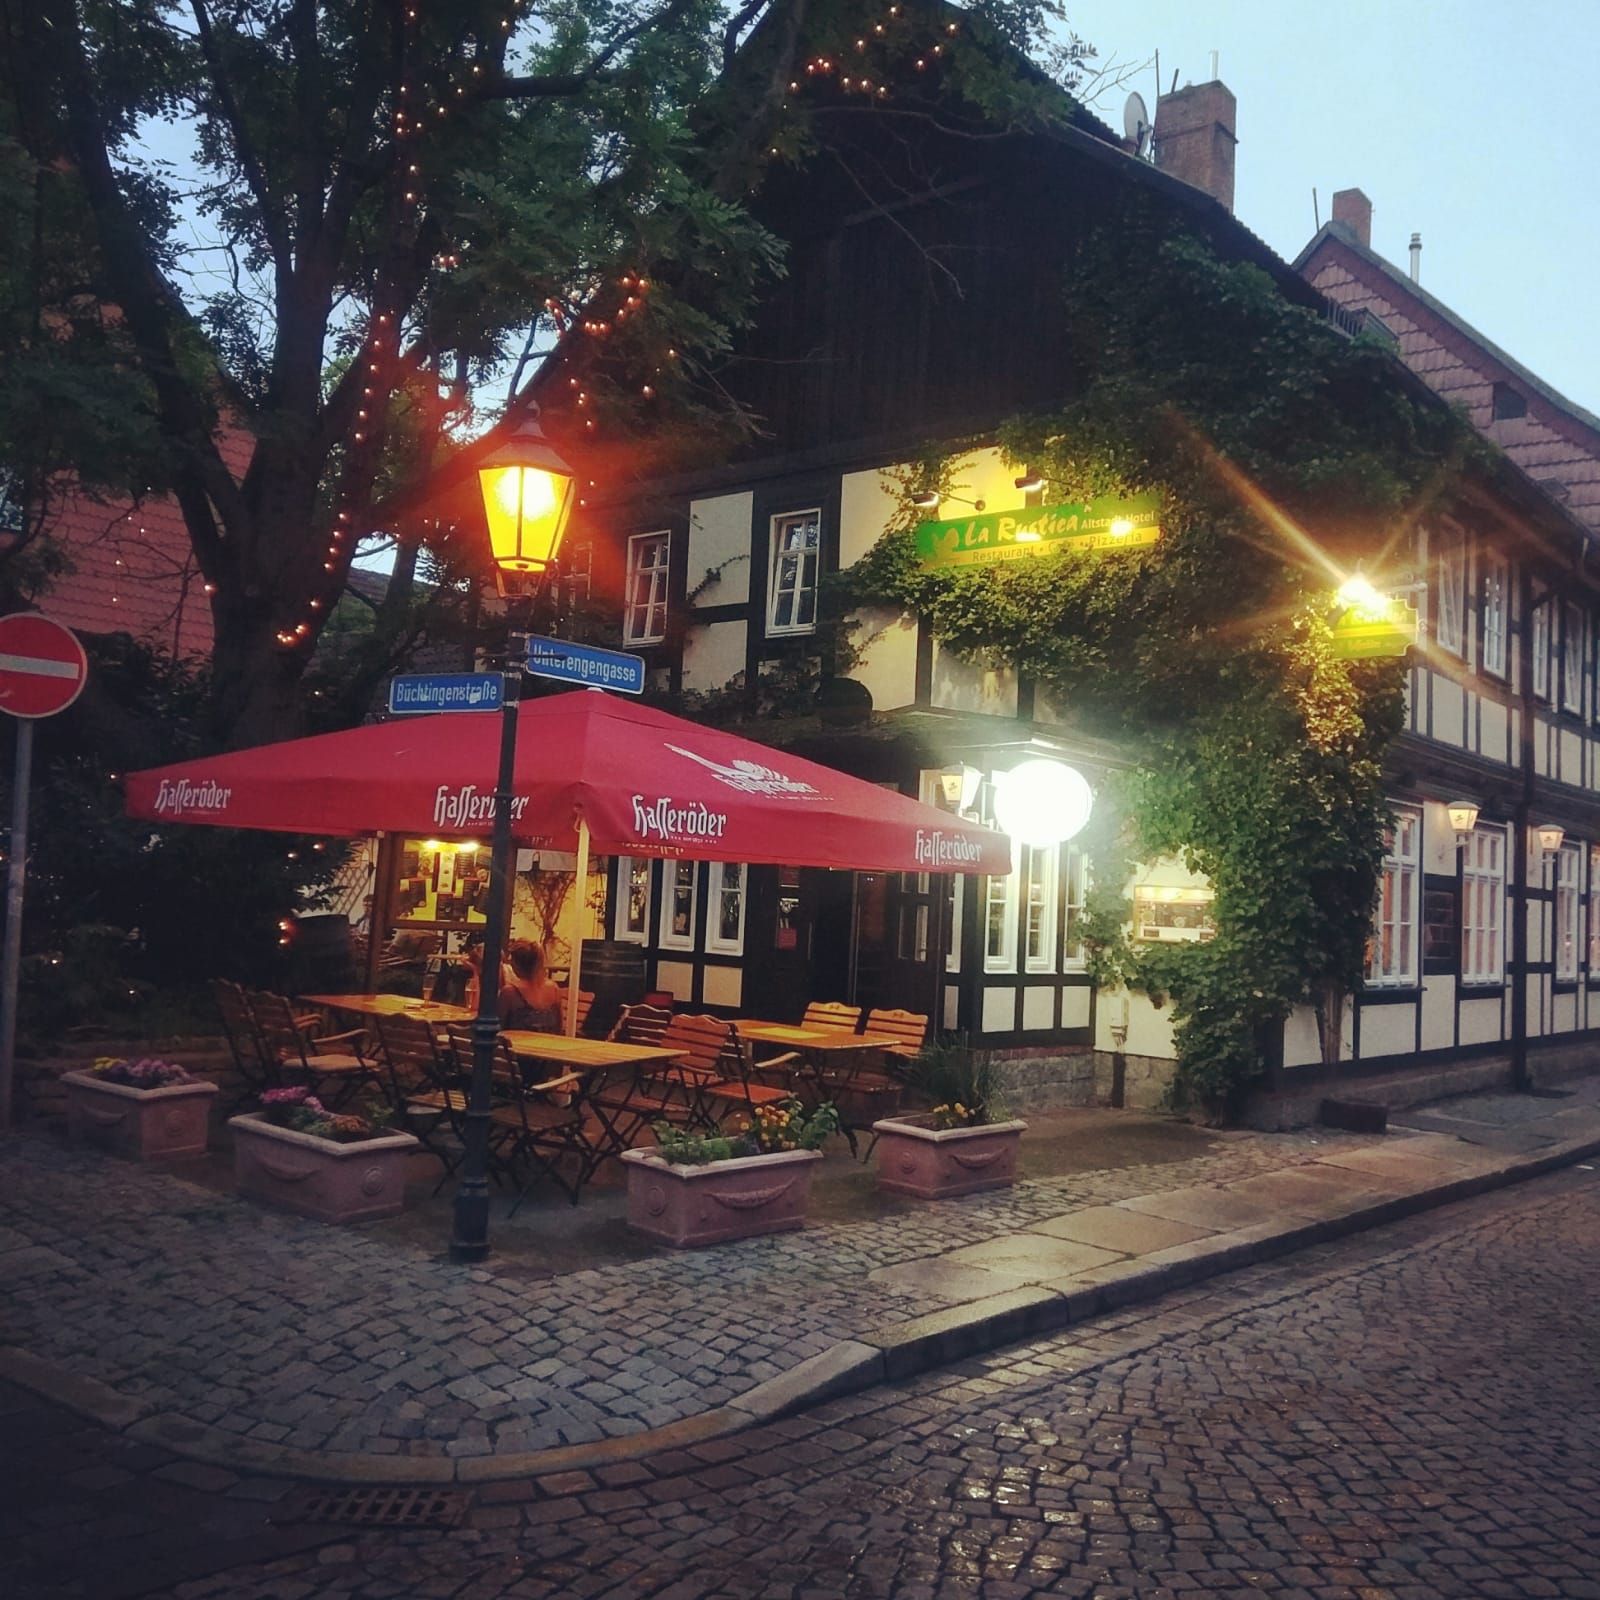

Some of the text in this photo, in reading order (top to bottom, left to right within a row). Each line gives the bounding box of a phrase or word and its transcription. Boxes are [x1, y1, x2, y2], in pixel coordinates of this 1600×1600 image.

[965, 513, 1078, 546] La Rustica
[972, 546, 1034, 561] Restaurant
[433, 785, 530, 827] Hasseröer
